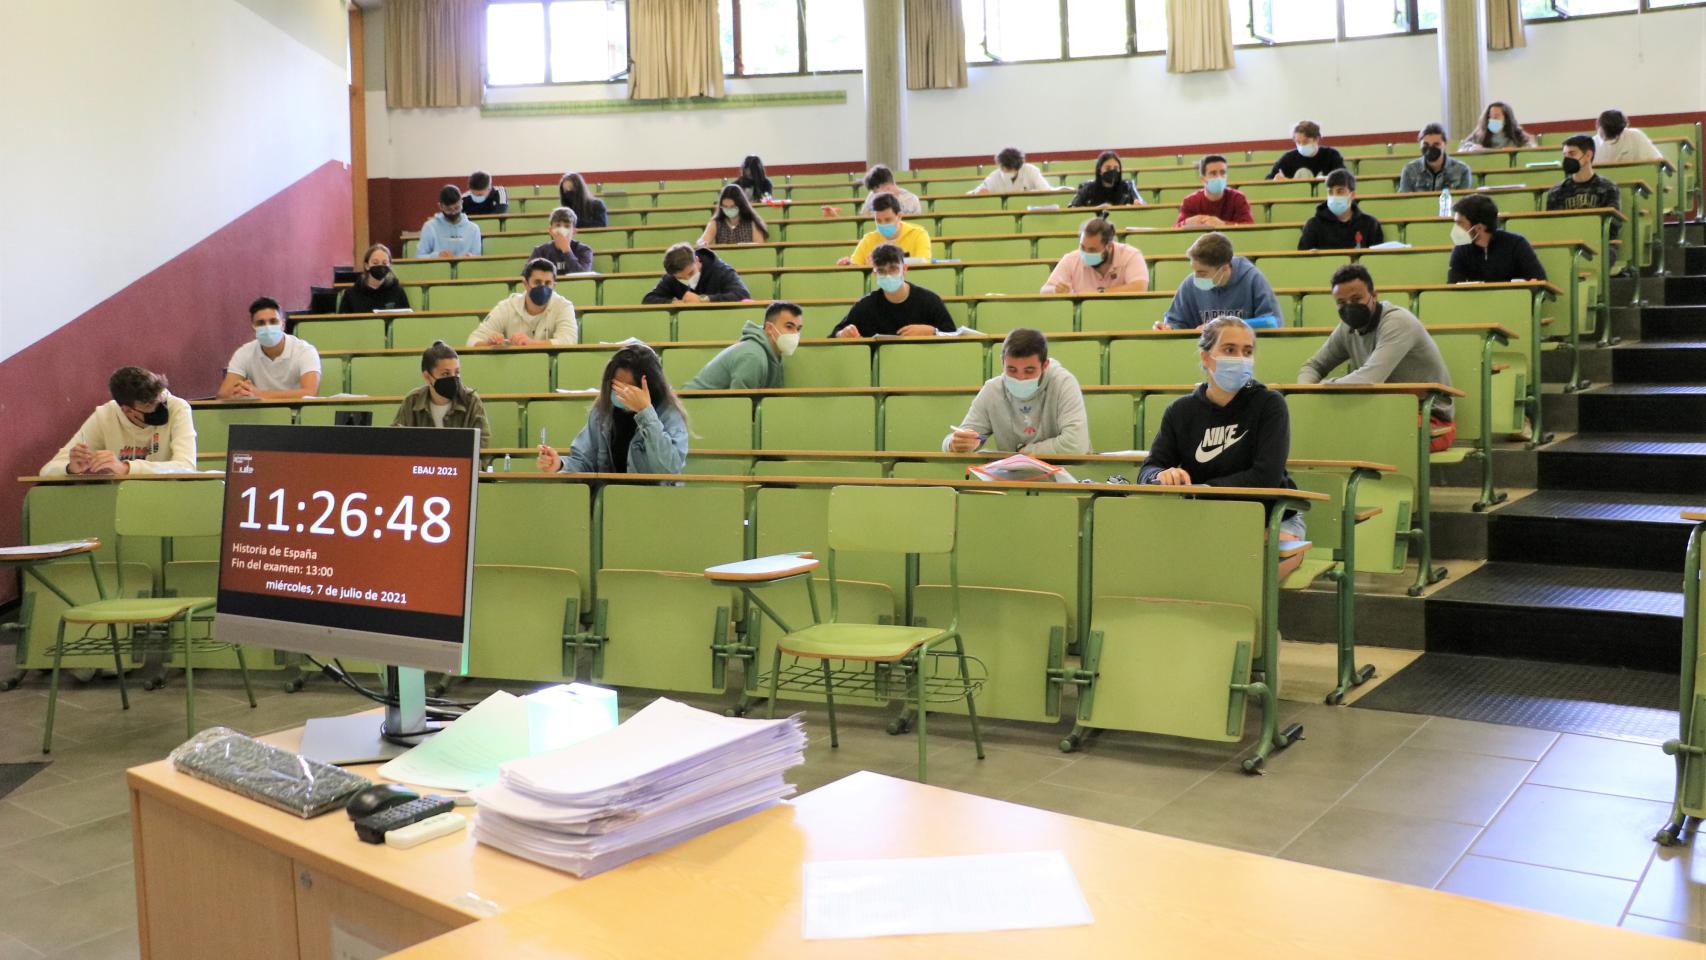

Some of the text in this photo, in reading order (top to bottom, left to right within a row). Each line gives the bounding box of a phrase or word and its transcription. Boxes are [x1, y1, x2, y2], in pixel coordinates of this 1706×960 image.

[1202, 424, 1239, 448] NIKE
[412, 465, 458, 476] EBAU 2021
[239, 486, 451, 544] 11:26:48
[232, 543, 318, 560] Historia de España
[231, 558, 334, 577] Fin del examen: 13:00
[266, 580, 407, 604] miércoles, 7 de julio de 2021
